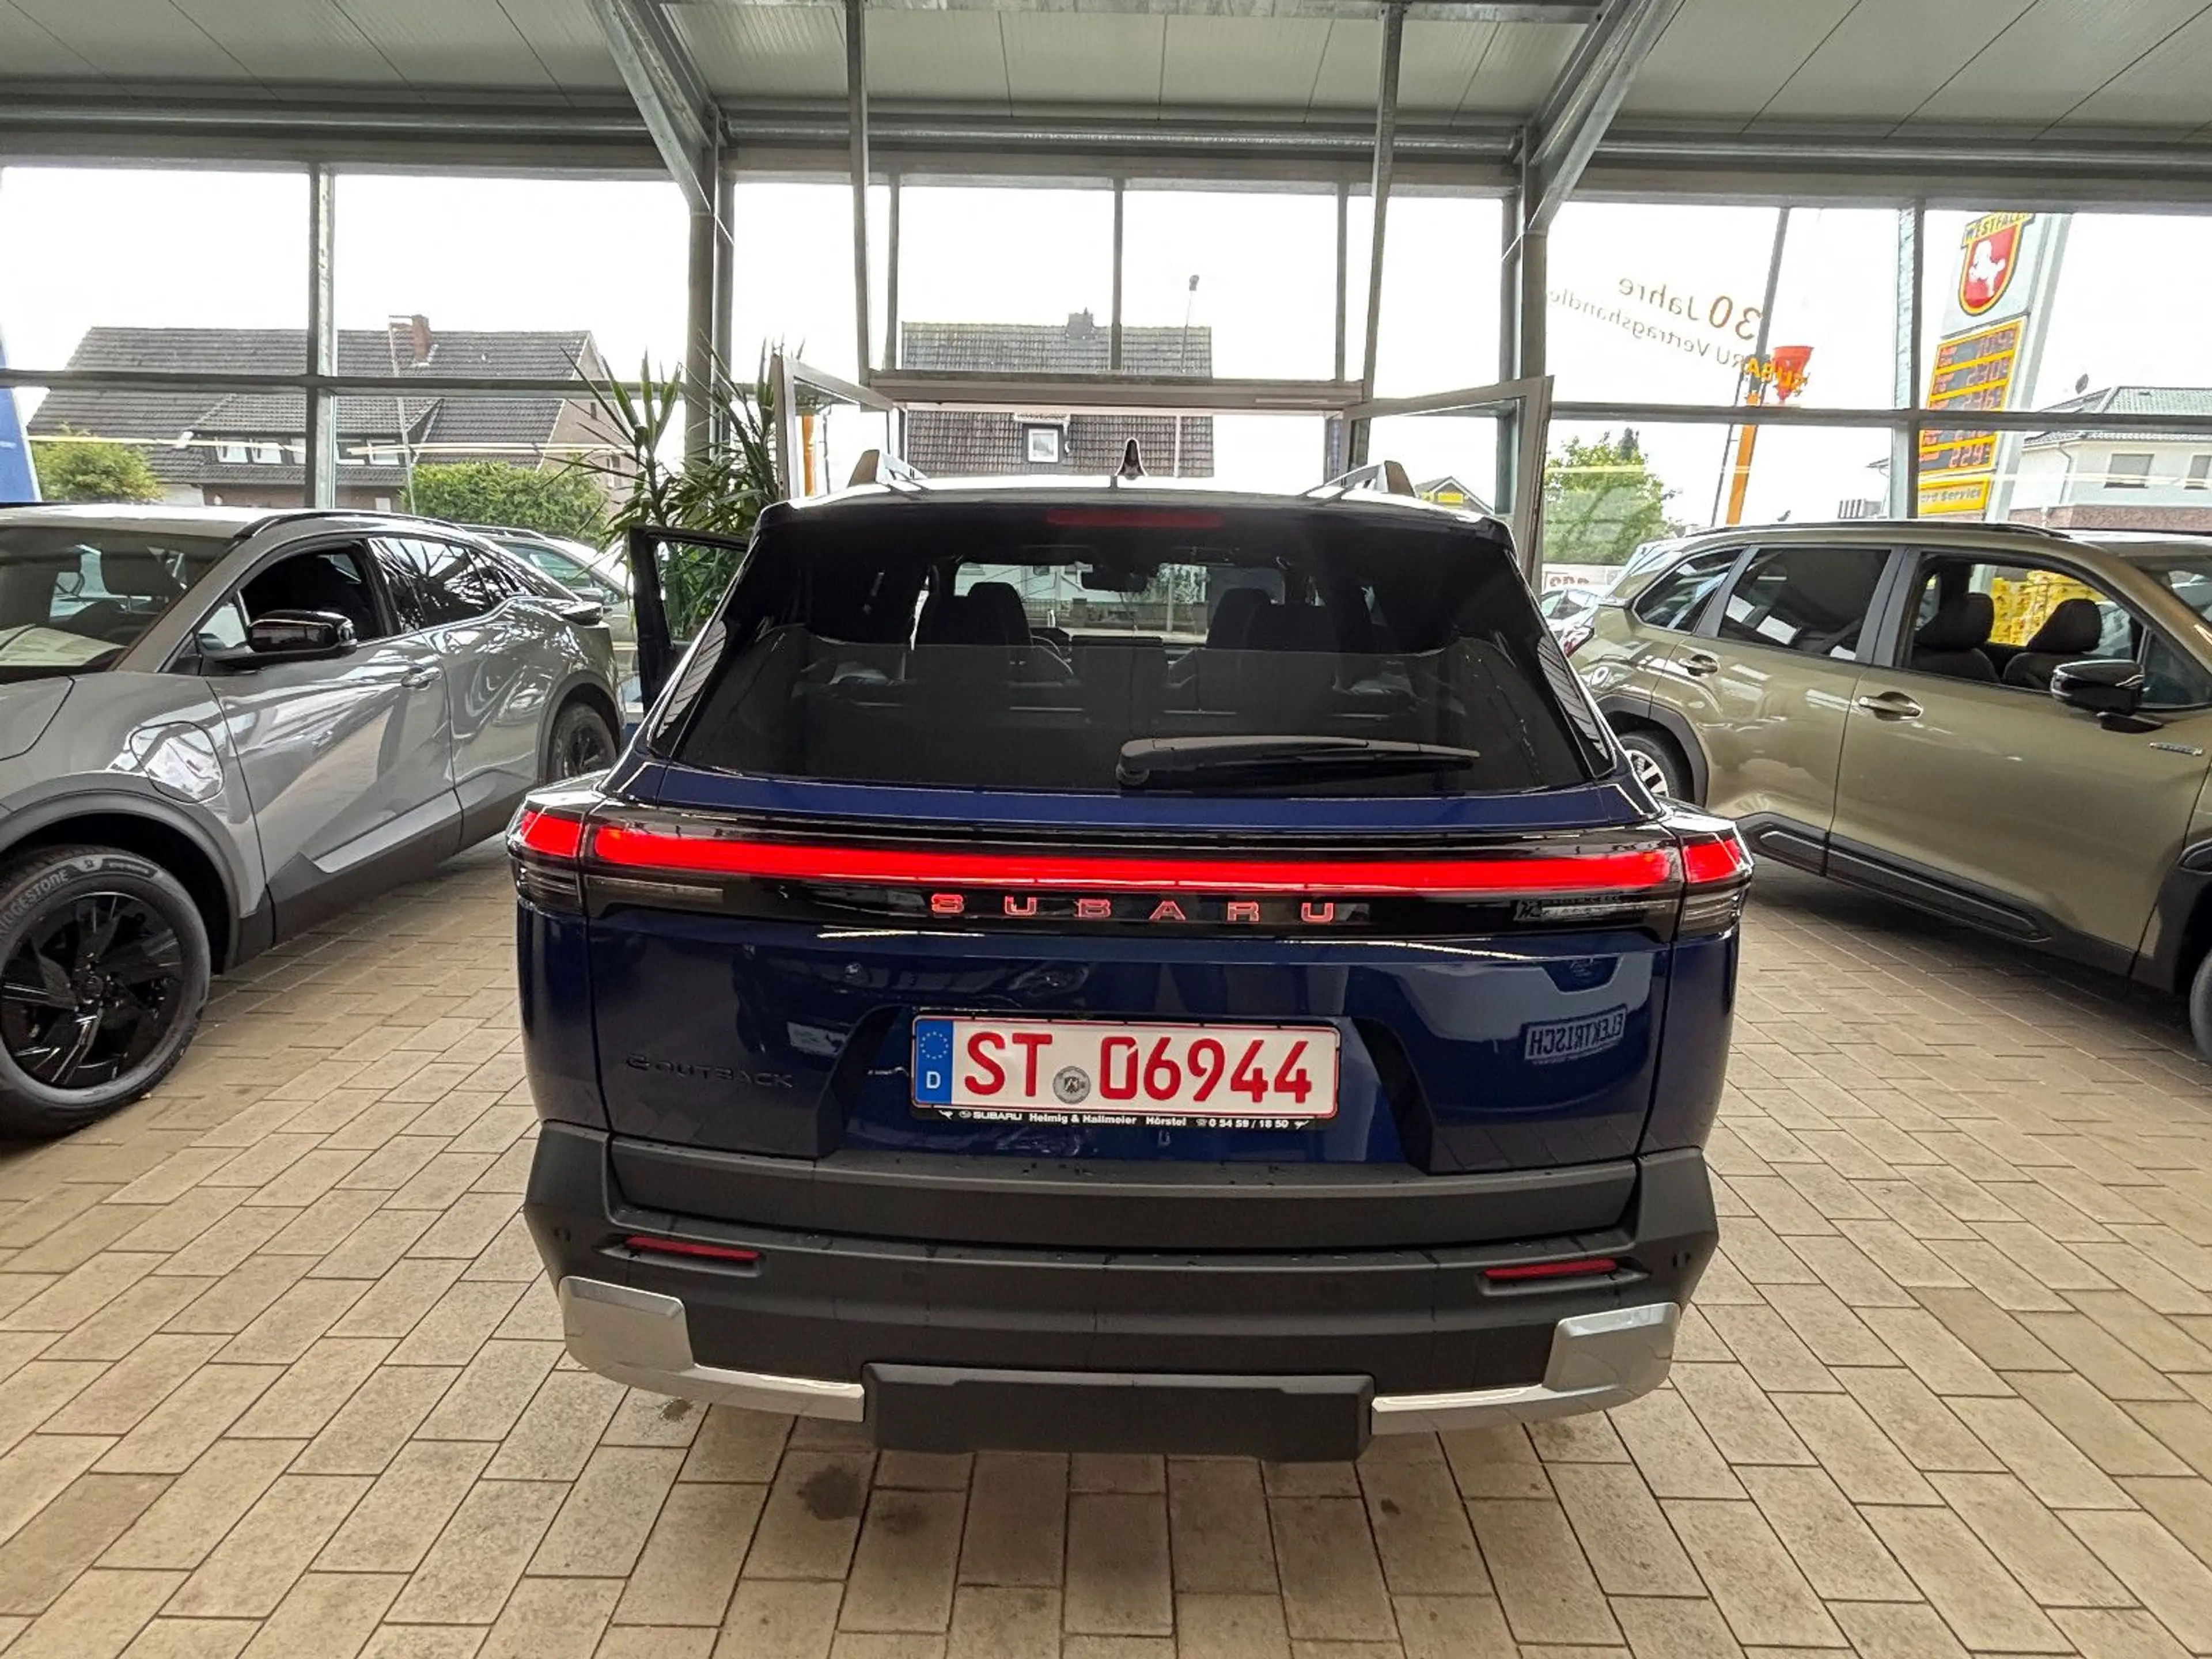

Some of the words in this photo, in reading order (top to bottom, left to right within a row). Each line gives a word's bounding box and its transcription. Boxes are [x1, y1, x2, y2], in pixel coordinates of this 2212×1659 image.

[931, 893, 1335, 923] SUBARU
[926, 1071, 941, 1089] D
[964, 1032, 1053, 1097] ST
[1099, 1036, 1312, 1104] 06944
[973, 1111, 1022, 1121] SUBARU
[1071, 1114, 1080, 1123] &
